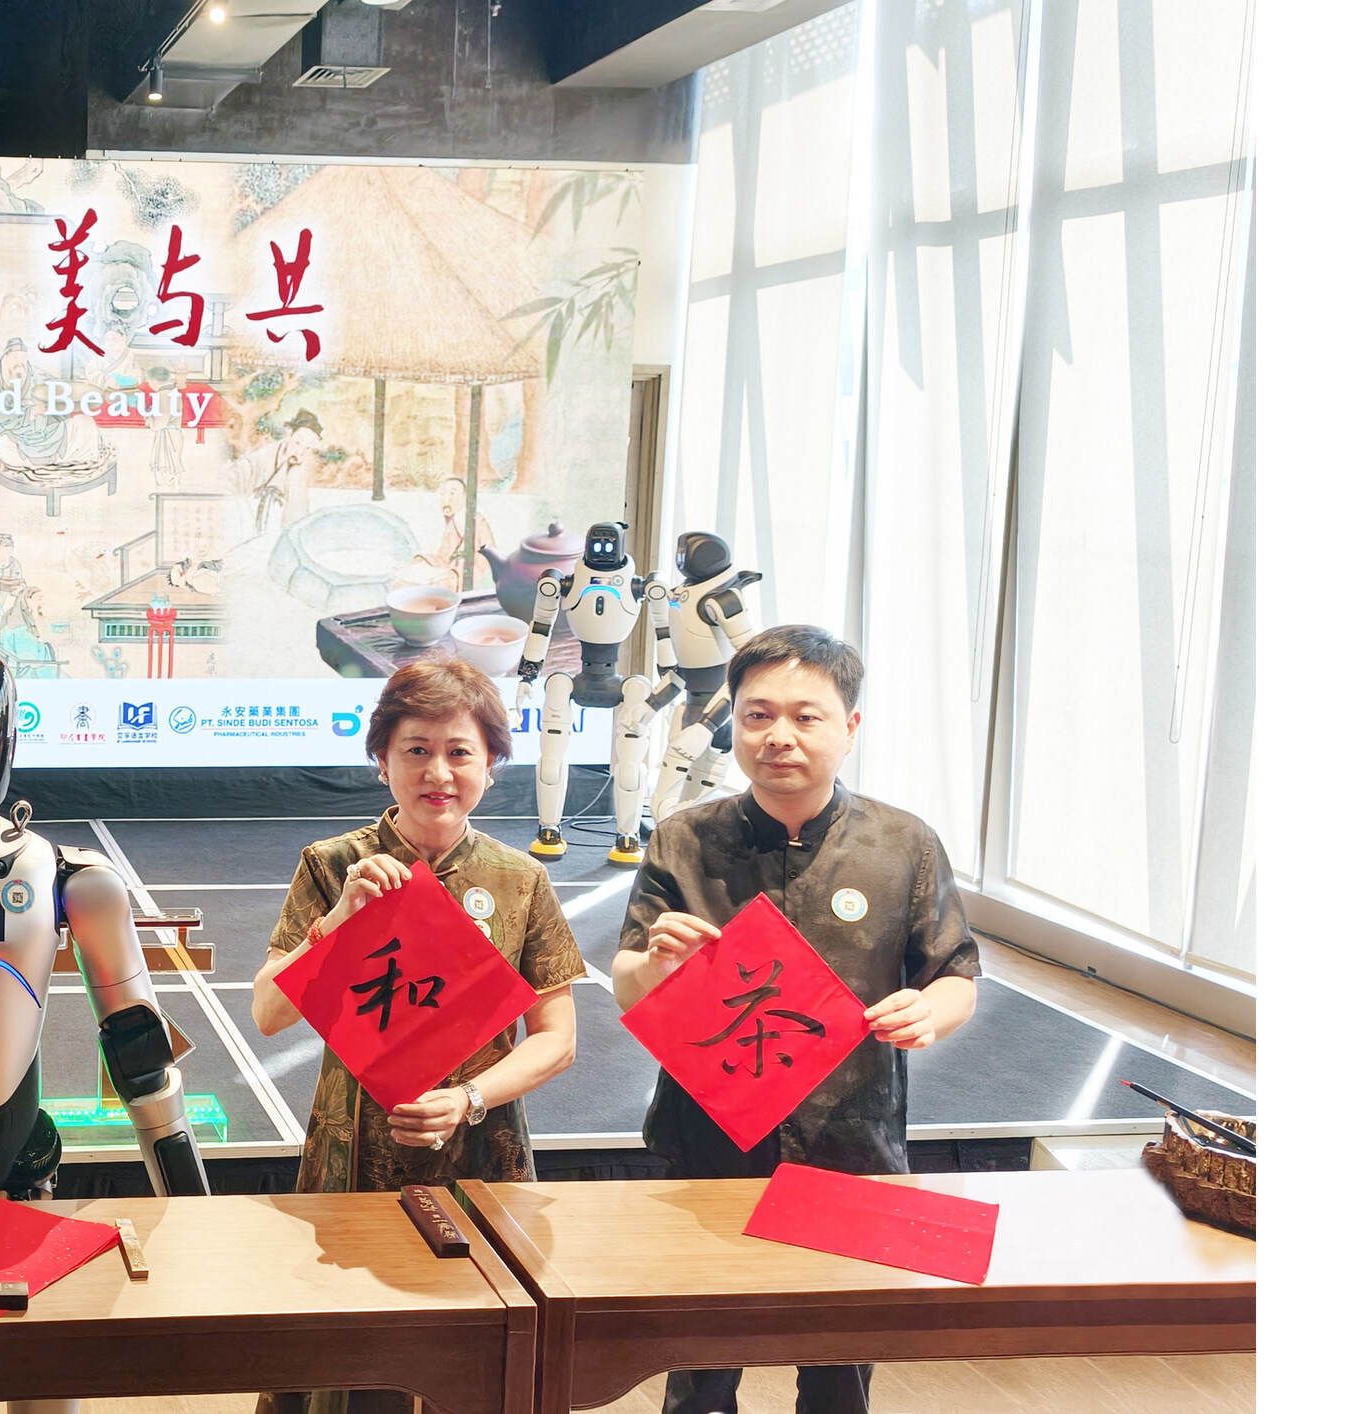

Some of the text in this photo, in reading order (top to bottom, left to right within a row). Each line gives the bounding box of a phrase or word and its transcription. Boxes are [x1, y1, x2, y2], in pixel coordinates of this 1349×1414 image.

[45, 380, 215, 427] Beauty
[201, 718, 319, 727] PT. SINDE BUDI SENTOSA
[349, 938, 446, 1032] 和
[684, 958, 827, 1079] 茶
